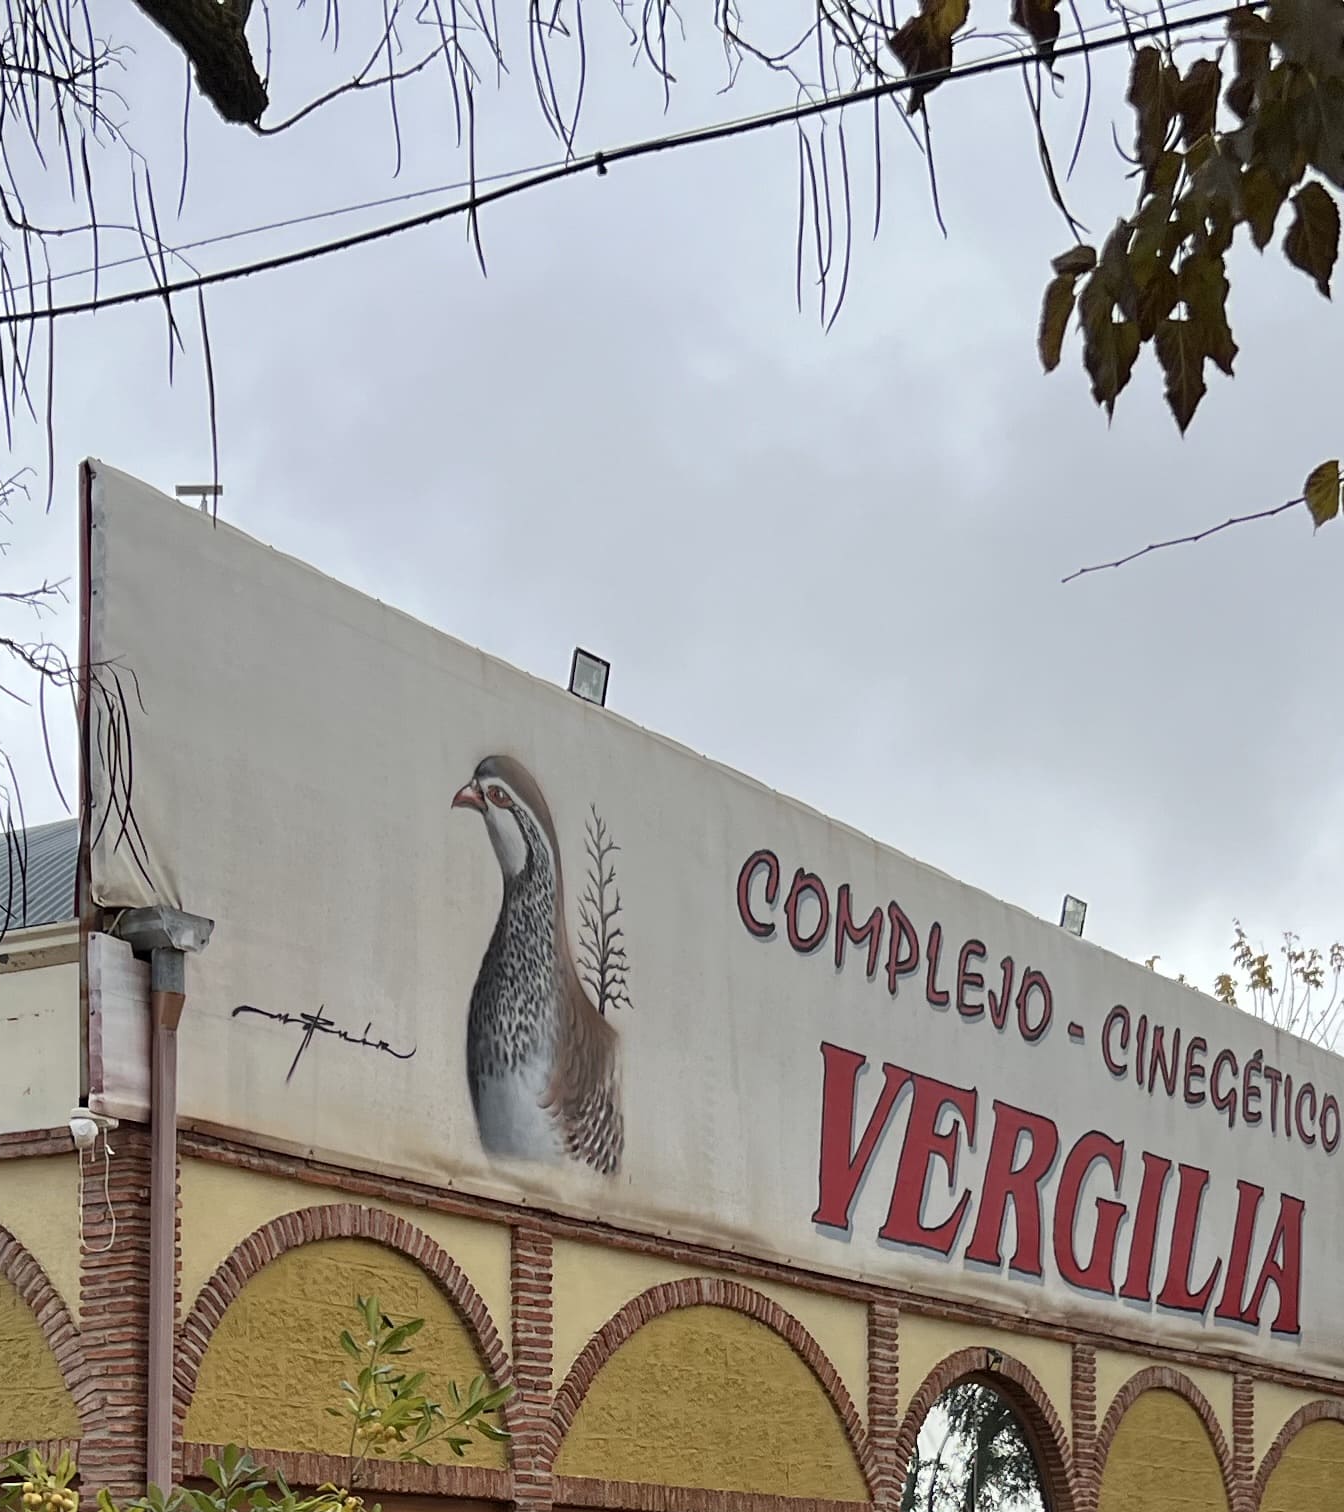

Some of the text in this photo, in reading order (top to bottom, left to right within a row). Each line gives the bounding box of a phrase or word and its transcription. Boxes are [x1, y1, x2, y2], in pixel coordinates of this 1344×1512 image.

[737, 849, 1052, 1042] COMPLEJO
[1102, 1004, 1340, 1152] CINEGÉTICO
[811, 1041, 1305, 1334] VERGILIA
